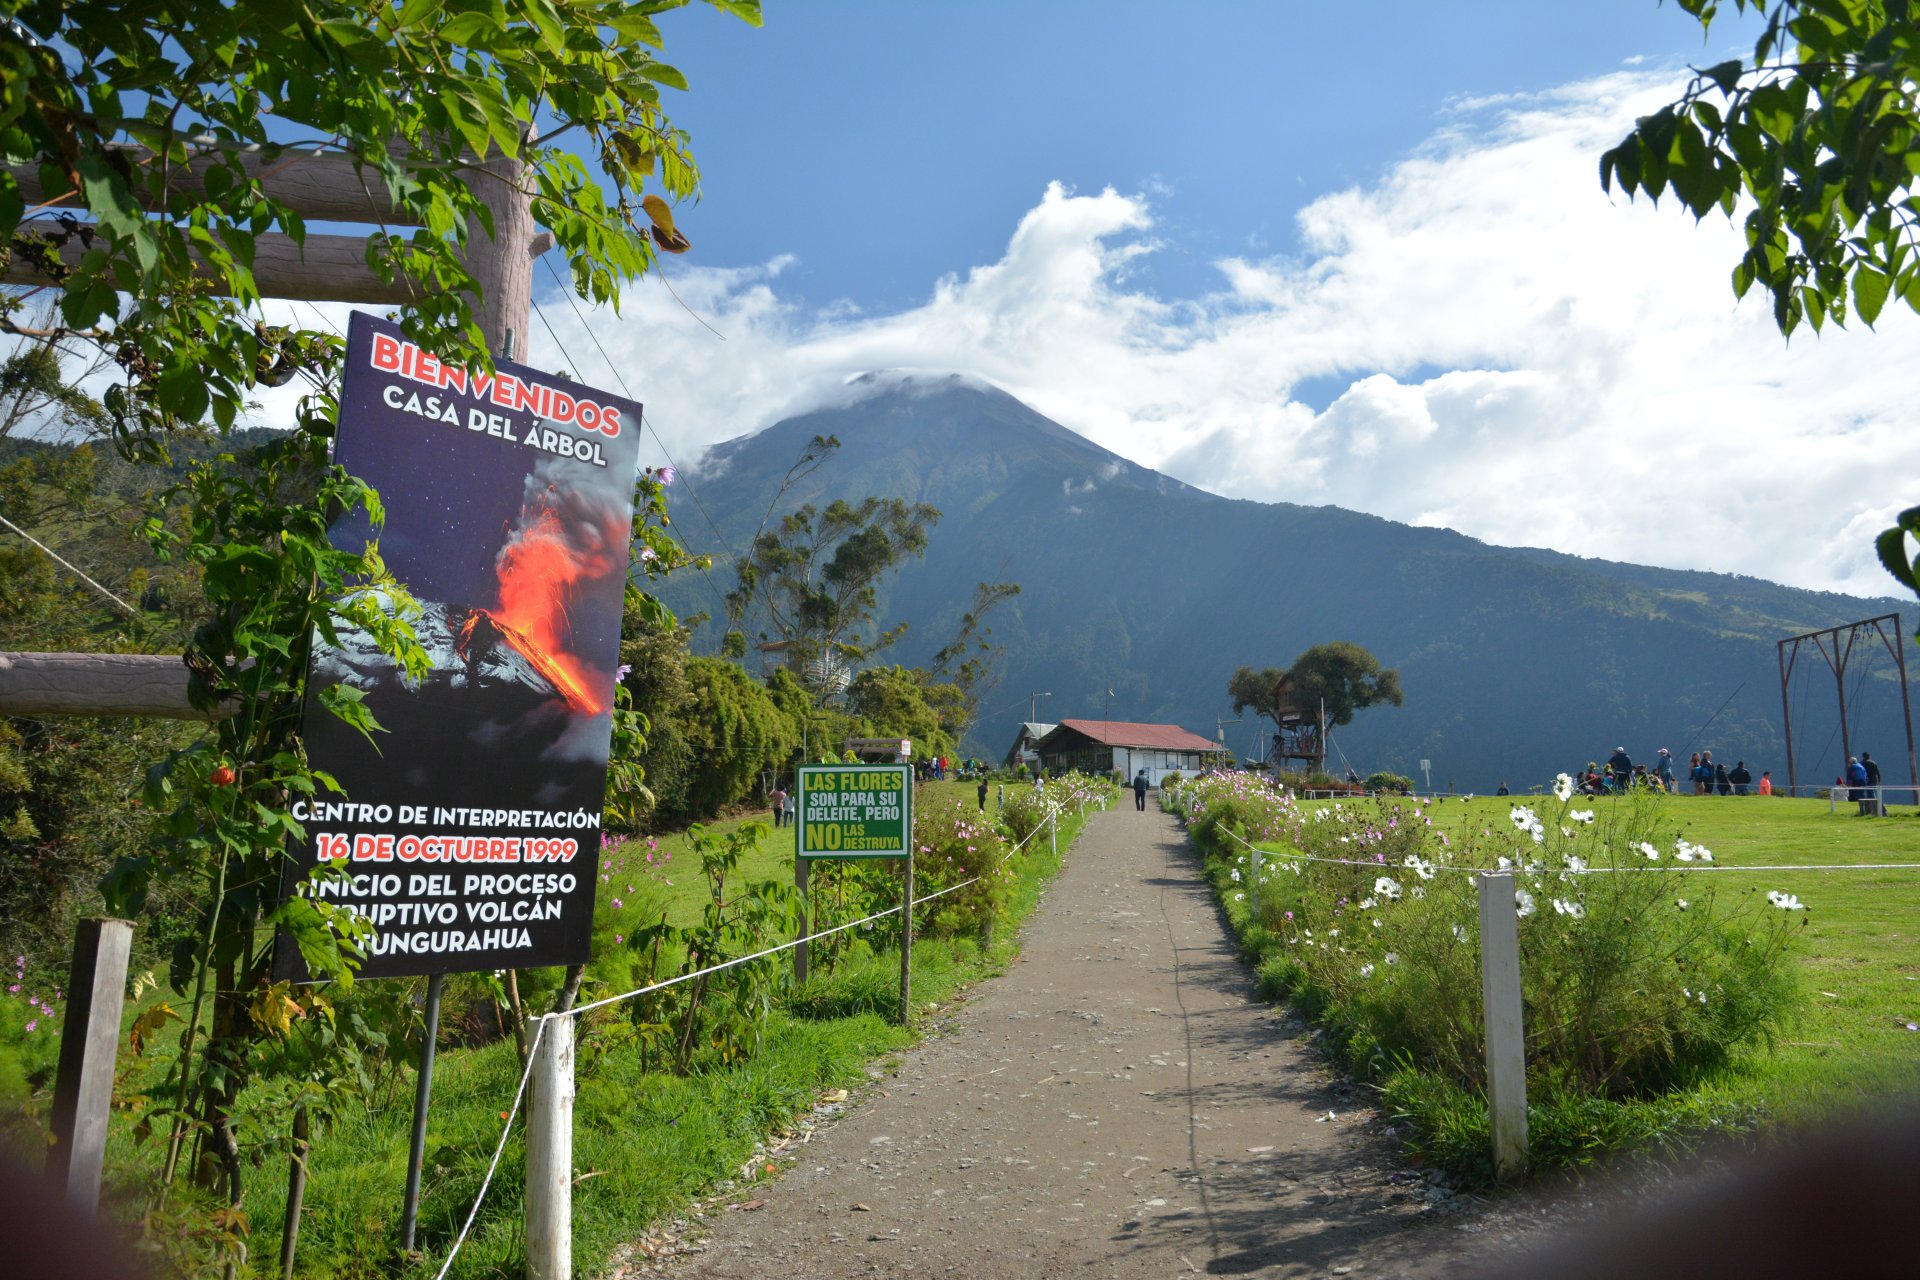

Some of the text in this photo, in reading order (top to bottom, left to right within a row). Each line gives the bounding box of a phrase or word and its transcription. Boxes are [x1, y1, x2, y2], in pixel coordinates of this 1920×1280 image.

[370, 332, 622, 438] BIENVENIDOS
[383, 385, 606, 467] CASA DEL ÁRBOL
[804, 772, 902, 791] LAS FLORES
[810, 791, 896, 806] SON PARA SU
[292, 801, 600, 828] CENTRO DE INTERPRETACIÓN
[807, 806, 899, 822] DELEITE, PERO
[806, 823, 841, 850] NO
[843, 824, 865, 836] LAS
[316, 833, 578, 862] 16 DE OCTUBRE 1999
[843, 837, 900, 849] DESTRUYA
[309, 873, 577, 897] INICIO DEL PROCESO
[465, 895, 562, 923] VOLCÁN
